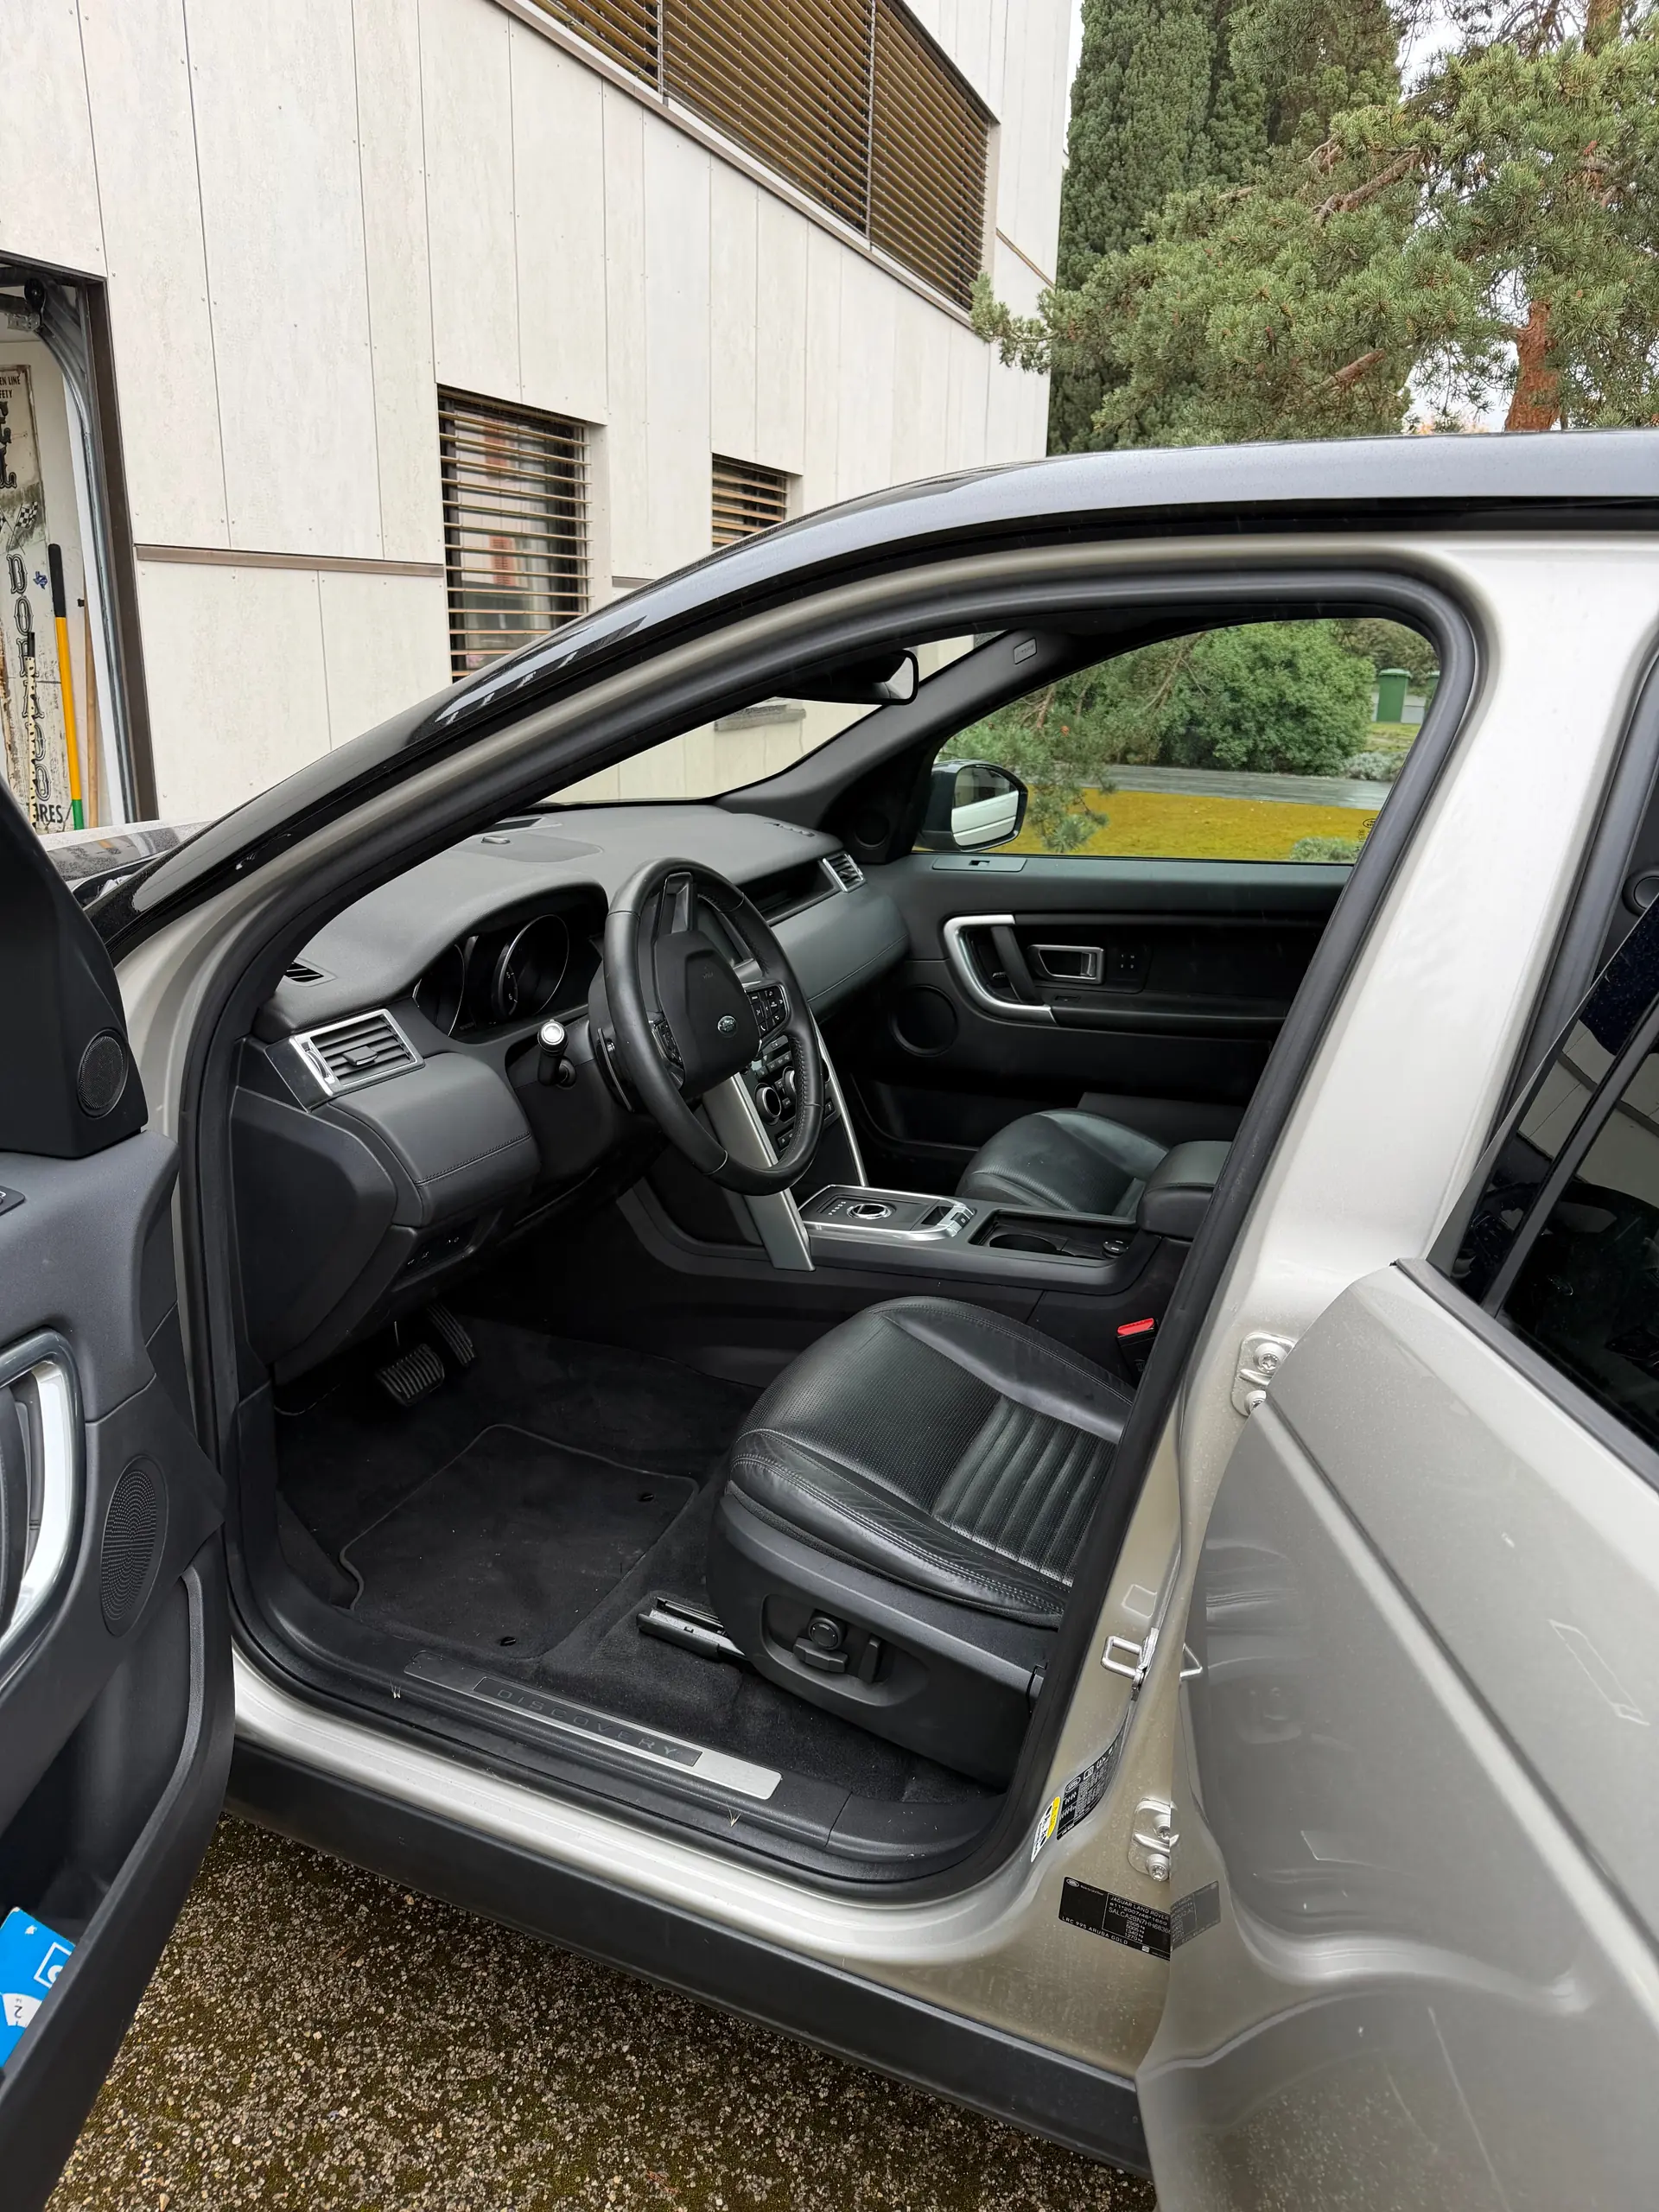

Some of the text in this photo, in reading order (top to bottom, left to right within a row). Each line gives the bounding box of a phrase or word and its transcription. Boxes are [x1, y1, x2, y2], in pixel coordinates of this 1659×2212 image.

[8, 376, 21, 385] LINE
[497, 1688, 678, 1756] DISCOVERY
[1110, 1896, 1169, 1921] JAGUAR LAND ROVER
[1062, 1916, 1074, 1924] LRC
[1089, 1926, 1109, 1938] ARUBA
[1110, 1935, 1128, 1945] GOLD
